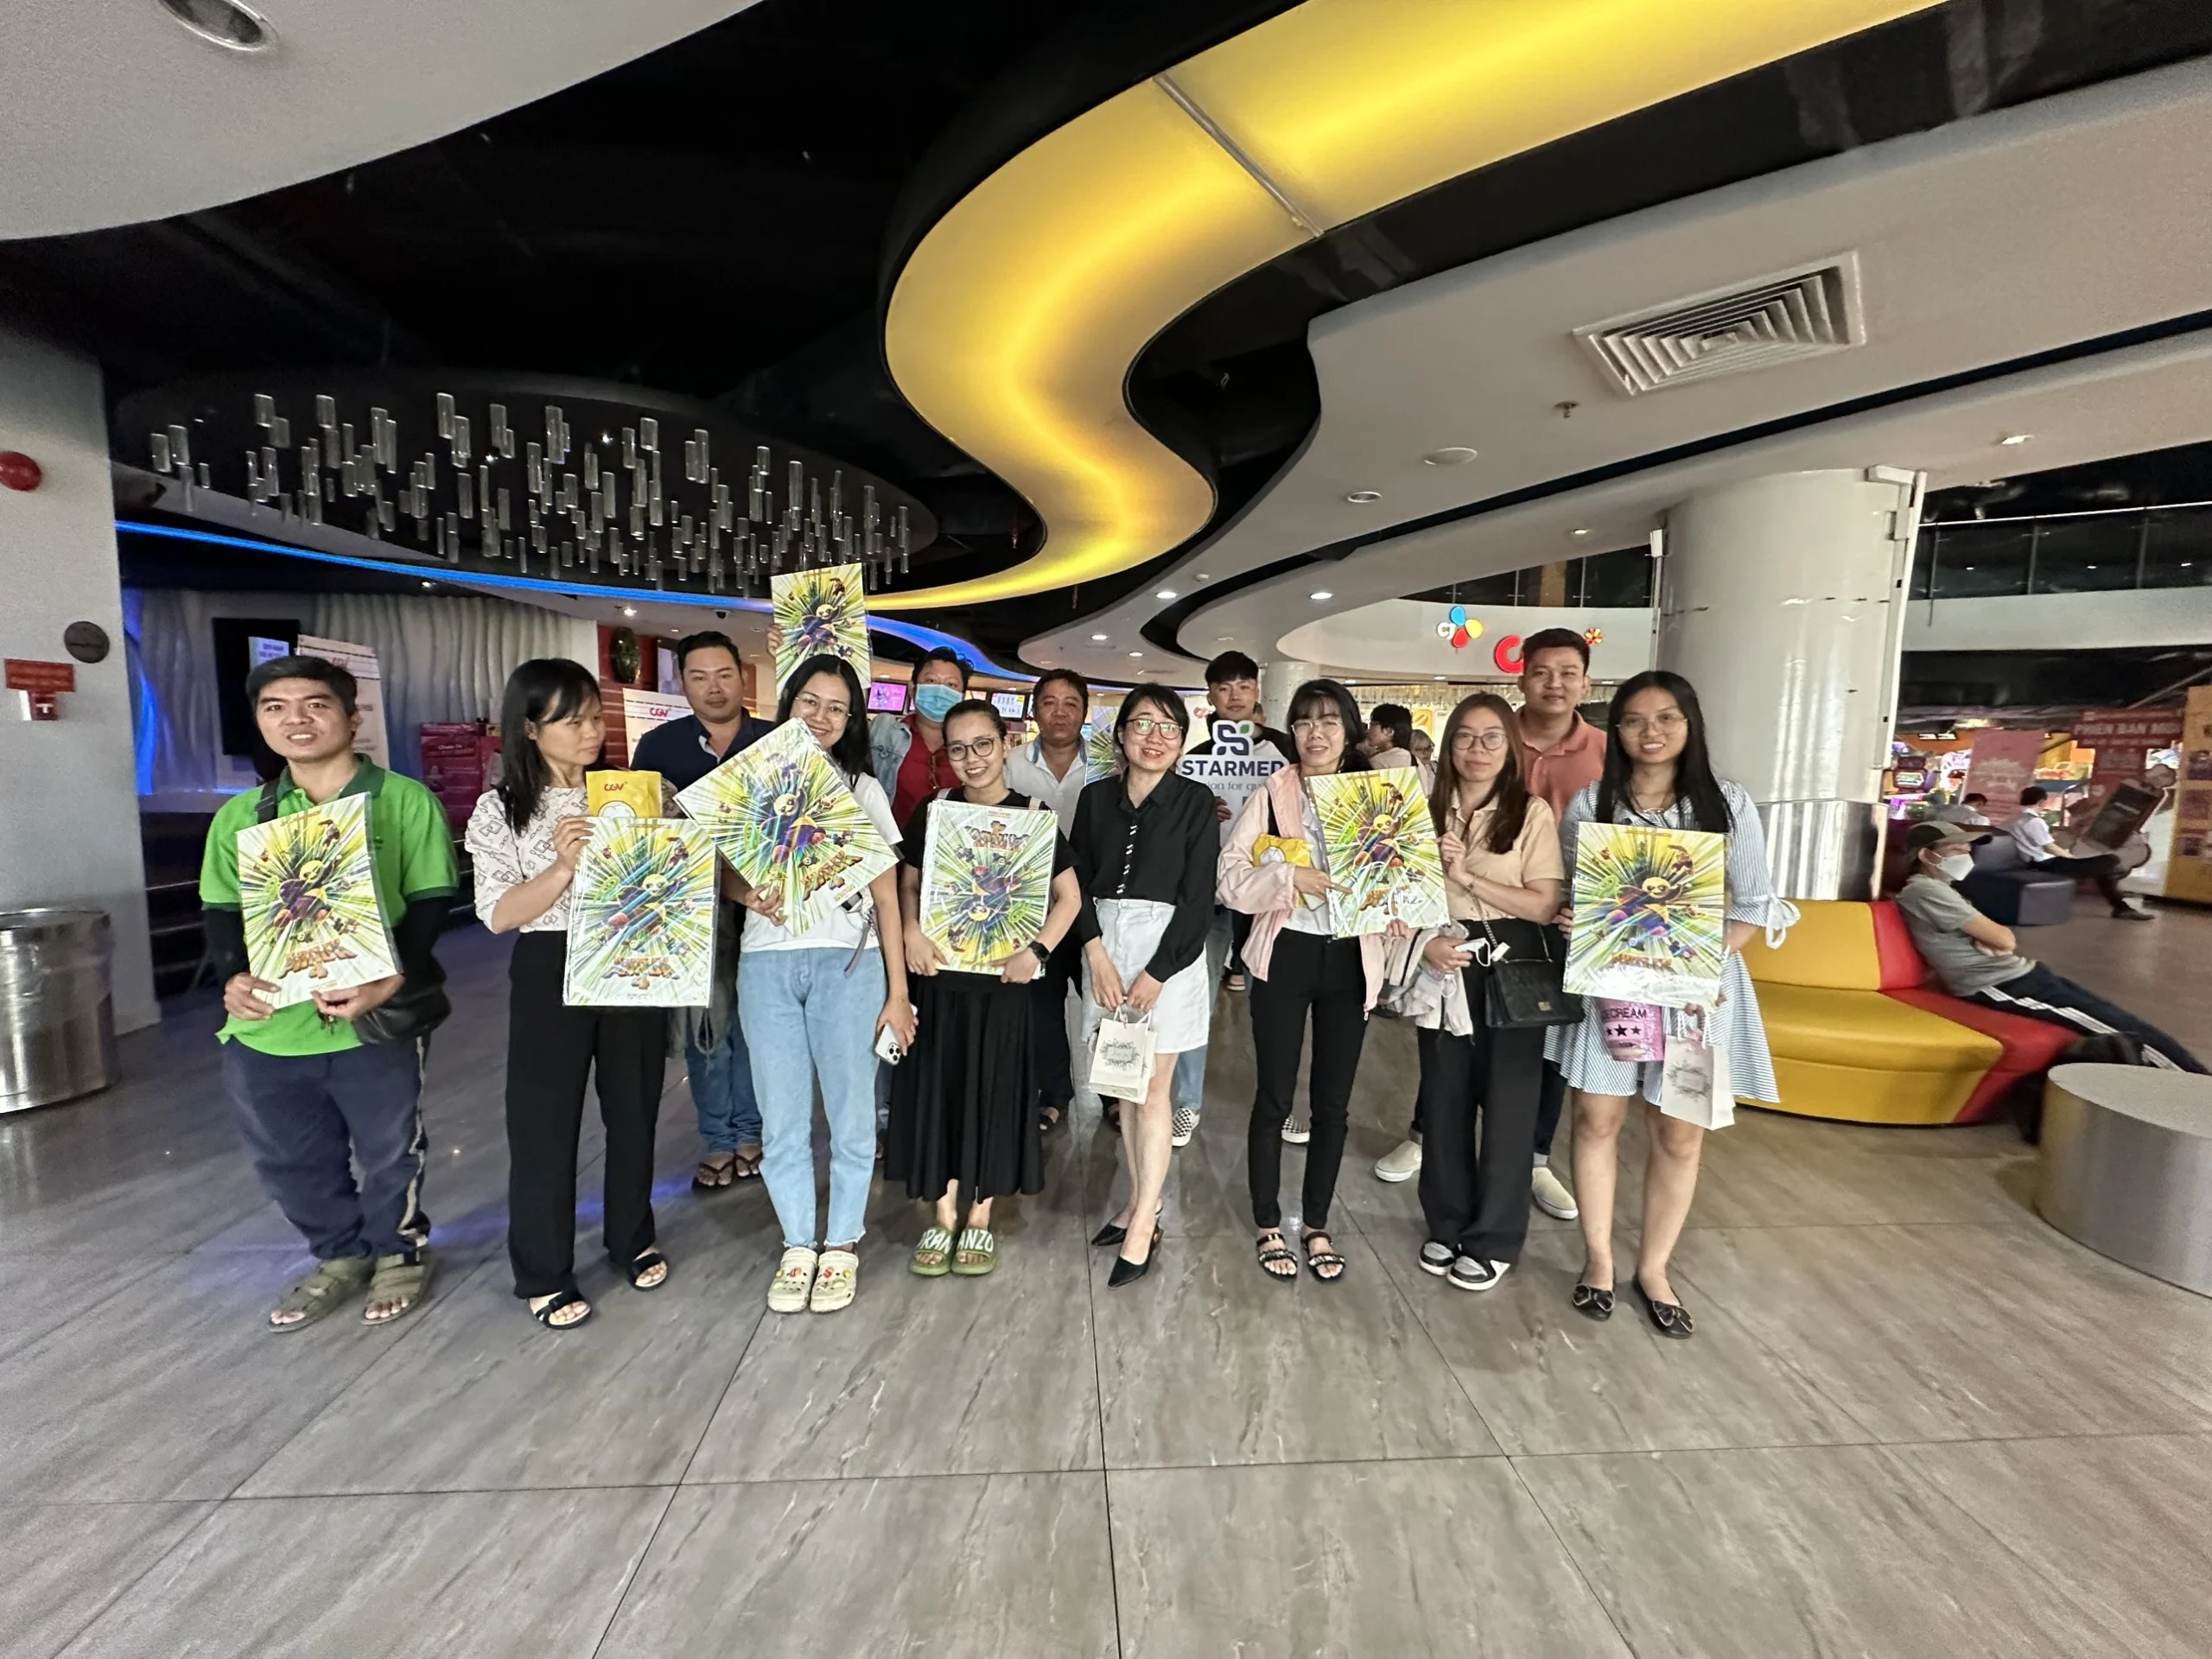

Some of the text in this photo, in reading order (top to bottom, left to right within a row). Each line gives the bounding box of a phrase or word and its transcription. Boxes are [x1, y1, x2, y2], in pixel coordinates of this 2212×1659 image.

[650, 708, 669, 717] CGV
[604, 783, 625, 791] CGV
[1228, 781, 1243, 791] for
